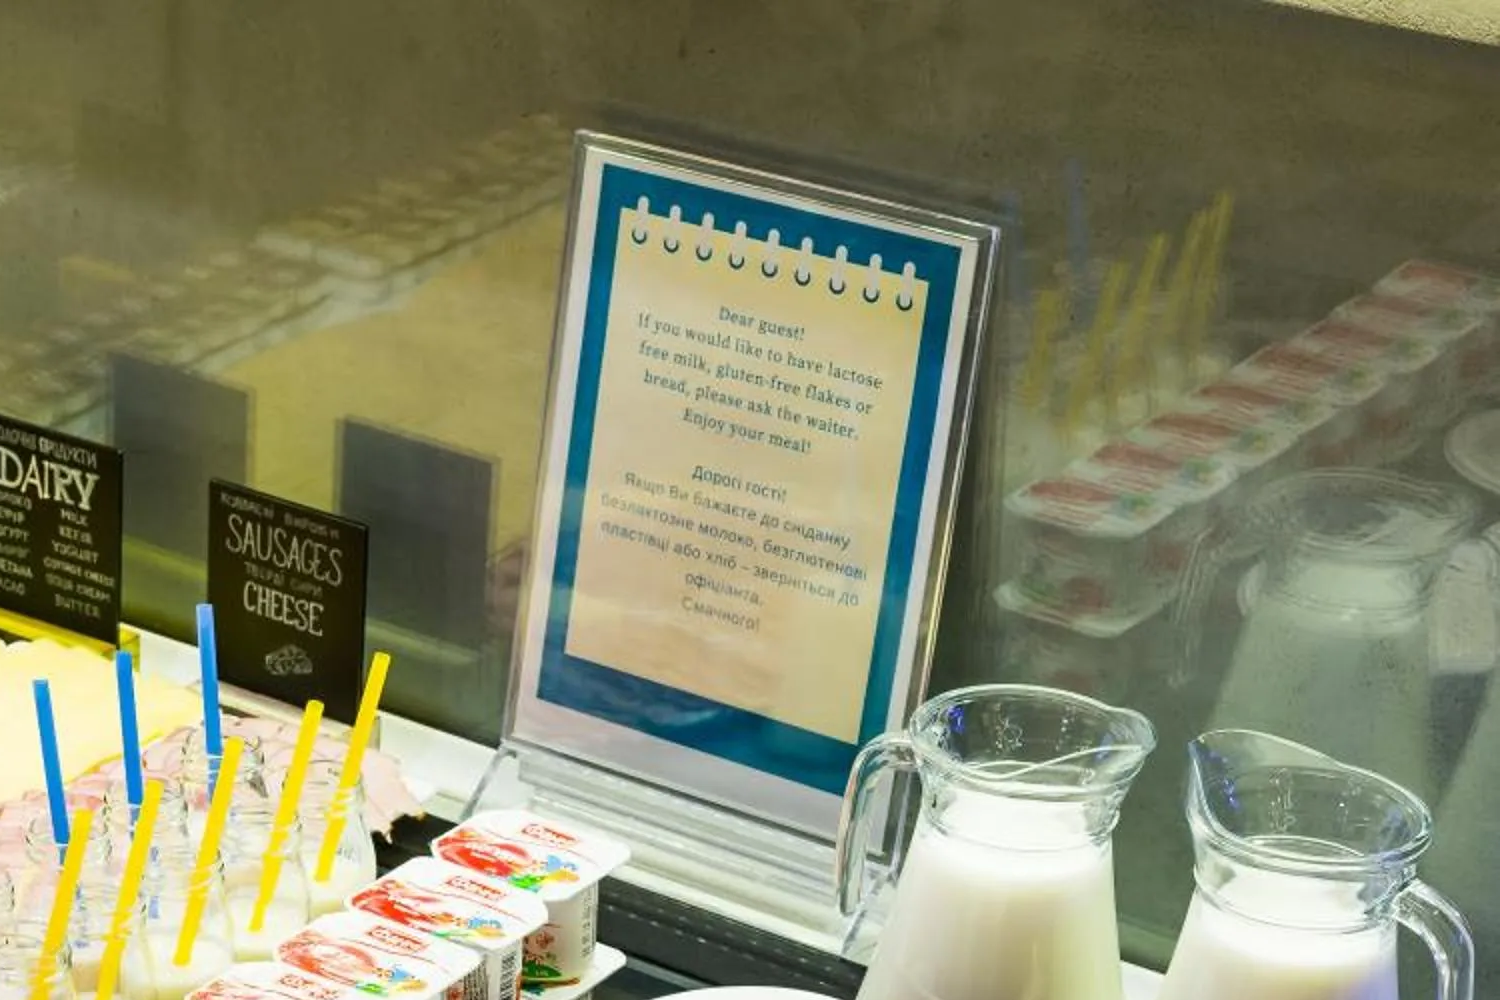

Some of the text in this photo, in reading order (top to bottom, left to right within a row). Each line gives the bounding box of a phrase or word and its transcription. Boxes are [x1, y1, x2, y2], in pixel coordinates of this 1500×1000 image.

[638, 312, 883, 391] If you would like to have lactose
[719, 306, 805, 341] Dear guest!
[639, 341, 874, 415] free milk, gluten-free flakes or
[643, 369, 860, 441] bread, please ask the waiter.
[683, 407, 812, 454] Enjoy your meal!
[624, 472, 851, 551] Якщо Ви бажаєте до сніданку
[691, 465, 787, 504] Дорогі гості!
[225, 513, 343, 587] SAUSAGES
[601, 494, 868, 581] безлактозне молоко, безглютенові
[601, 520, 671, 553] пластівці
[673, 541, 701, 560] або
[705, 550, 737, 571] хліб
[753, 565, 835, 599] зверніться
[838, 590, 859, 608] до
[243, 580, 324, 637] CHEESE
